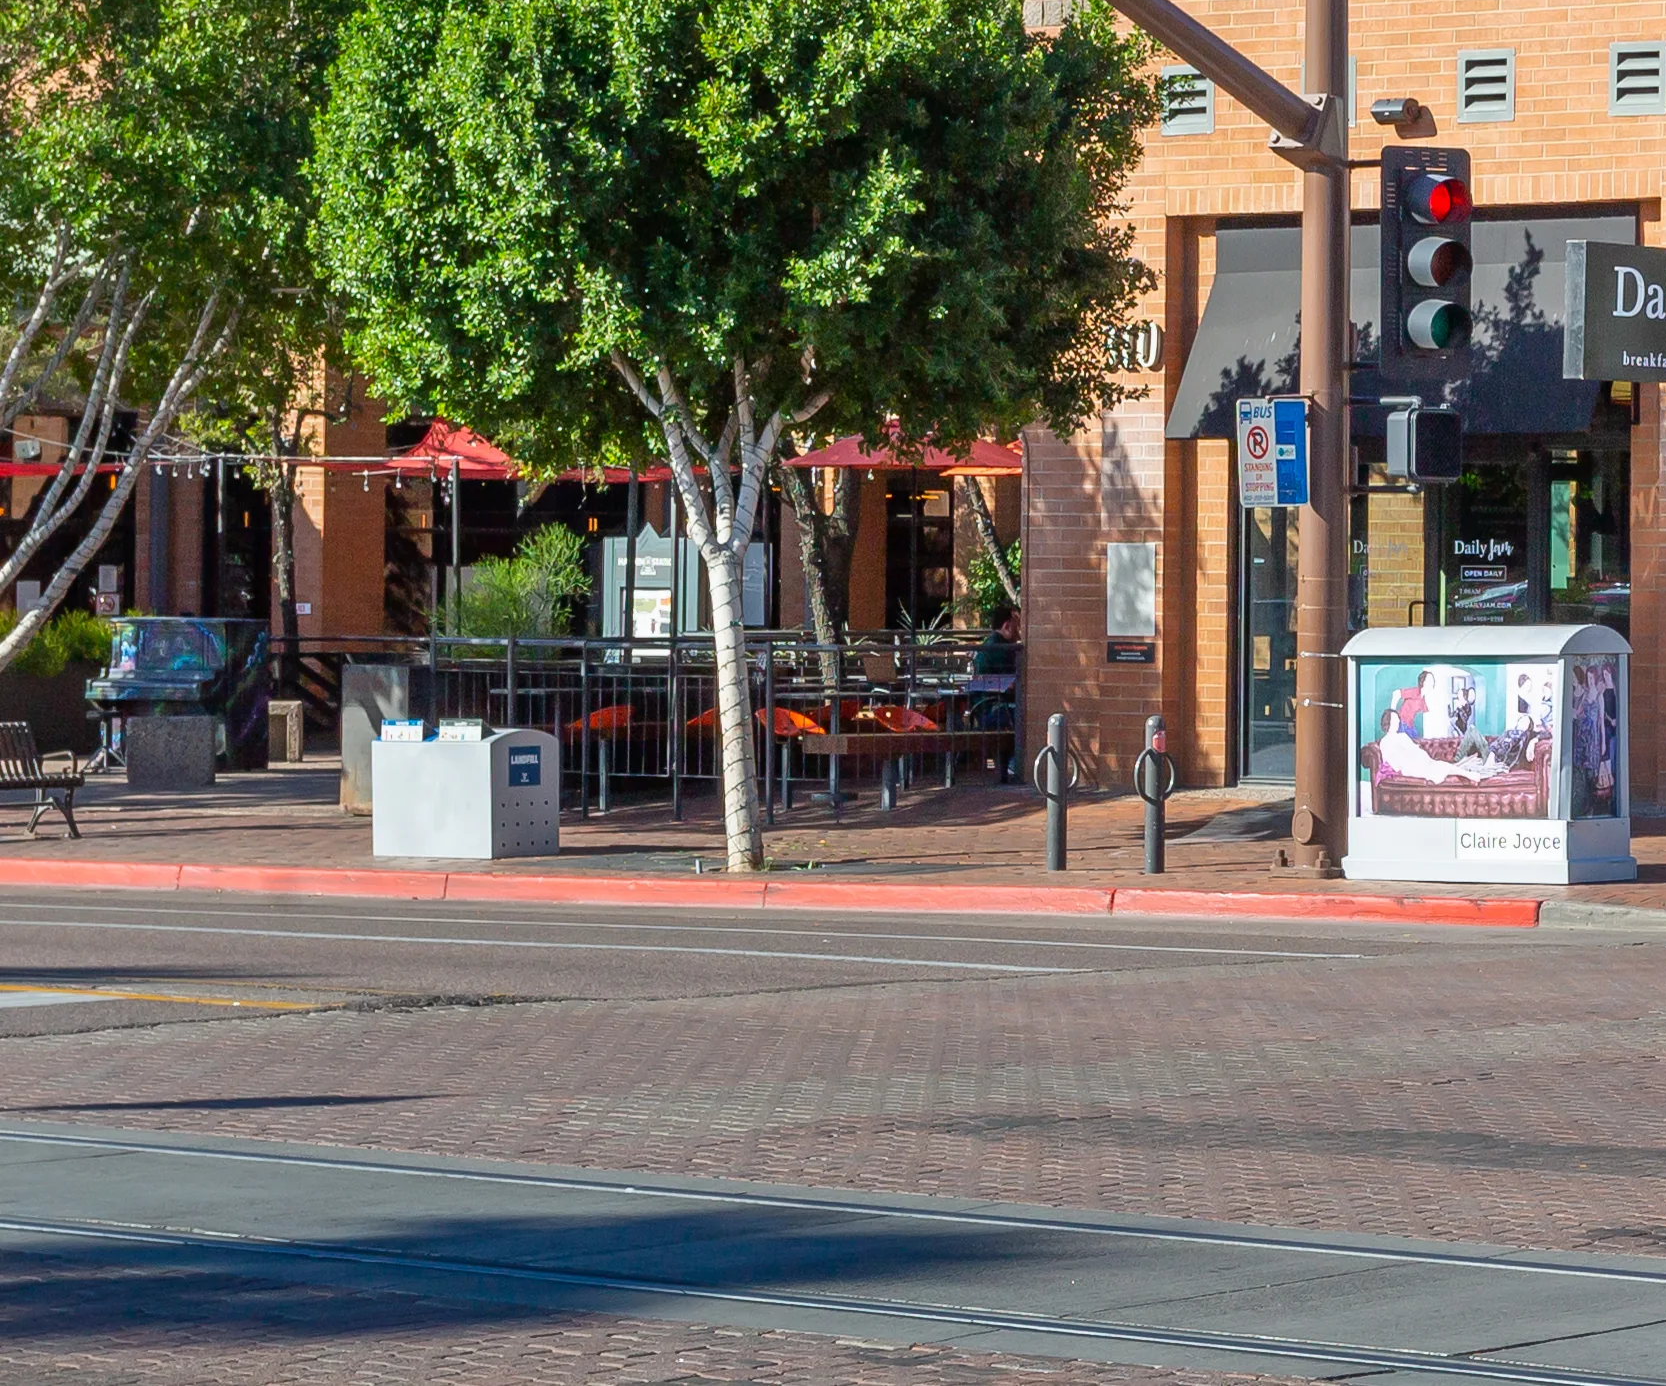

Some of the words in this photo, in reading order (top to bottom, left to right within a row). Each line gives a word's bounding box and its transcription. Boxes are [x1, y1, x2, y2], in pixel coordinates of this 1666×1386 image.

[1254, 407, 1272, 418] BUS
[1244, 463, 1273, 472] STANDING
[1245, 482, 1275, 492] STOPPING
[1454, 539, 1488, 559] Daily
[1488, 539, 1514, 561] Jam
[1460, 831, 1508, 850] Claire
[1512, 832, 1561, 854] Joyce
